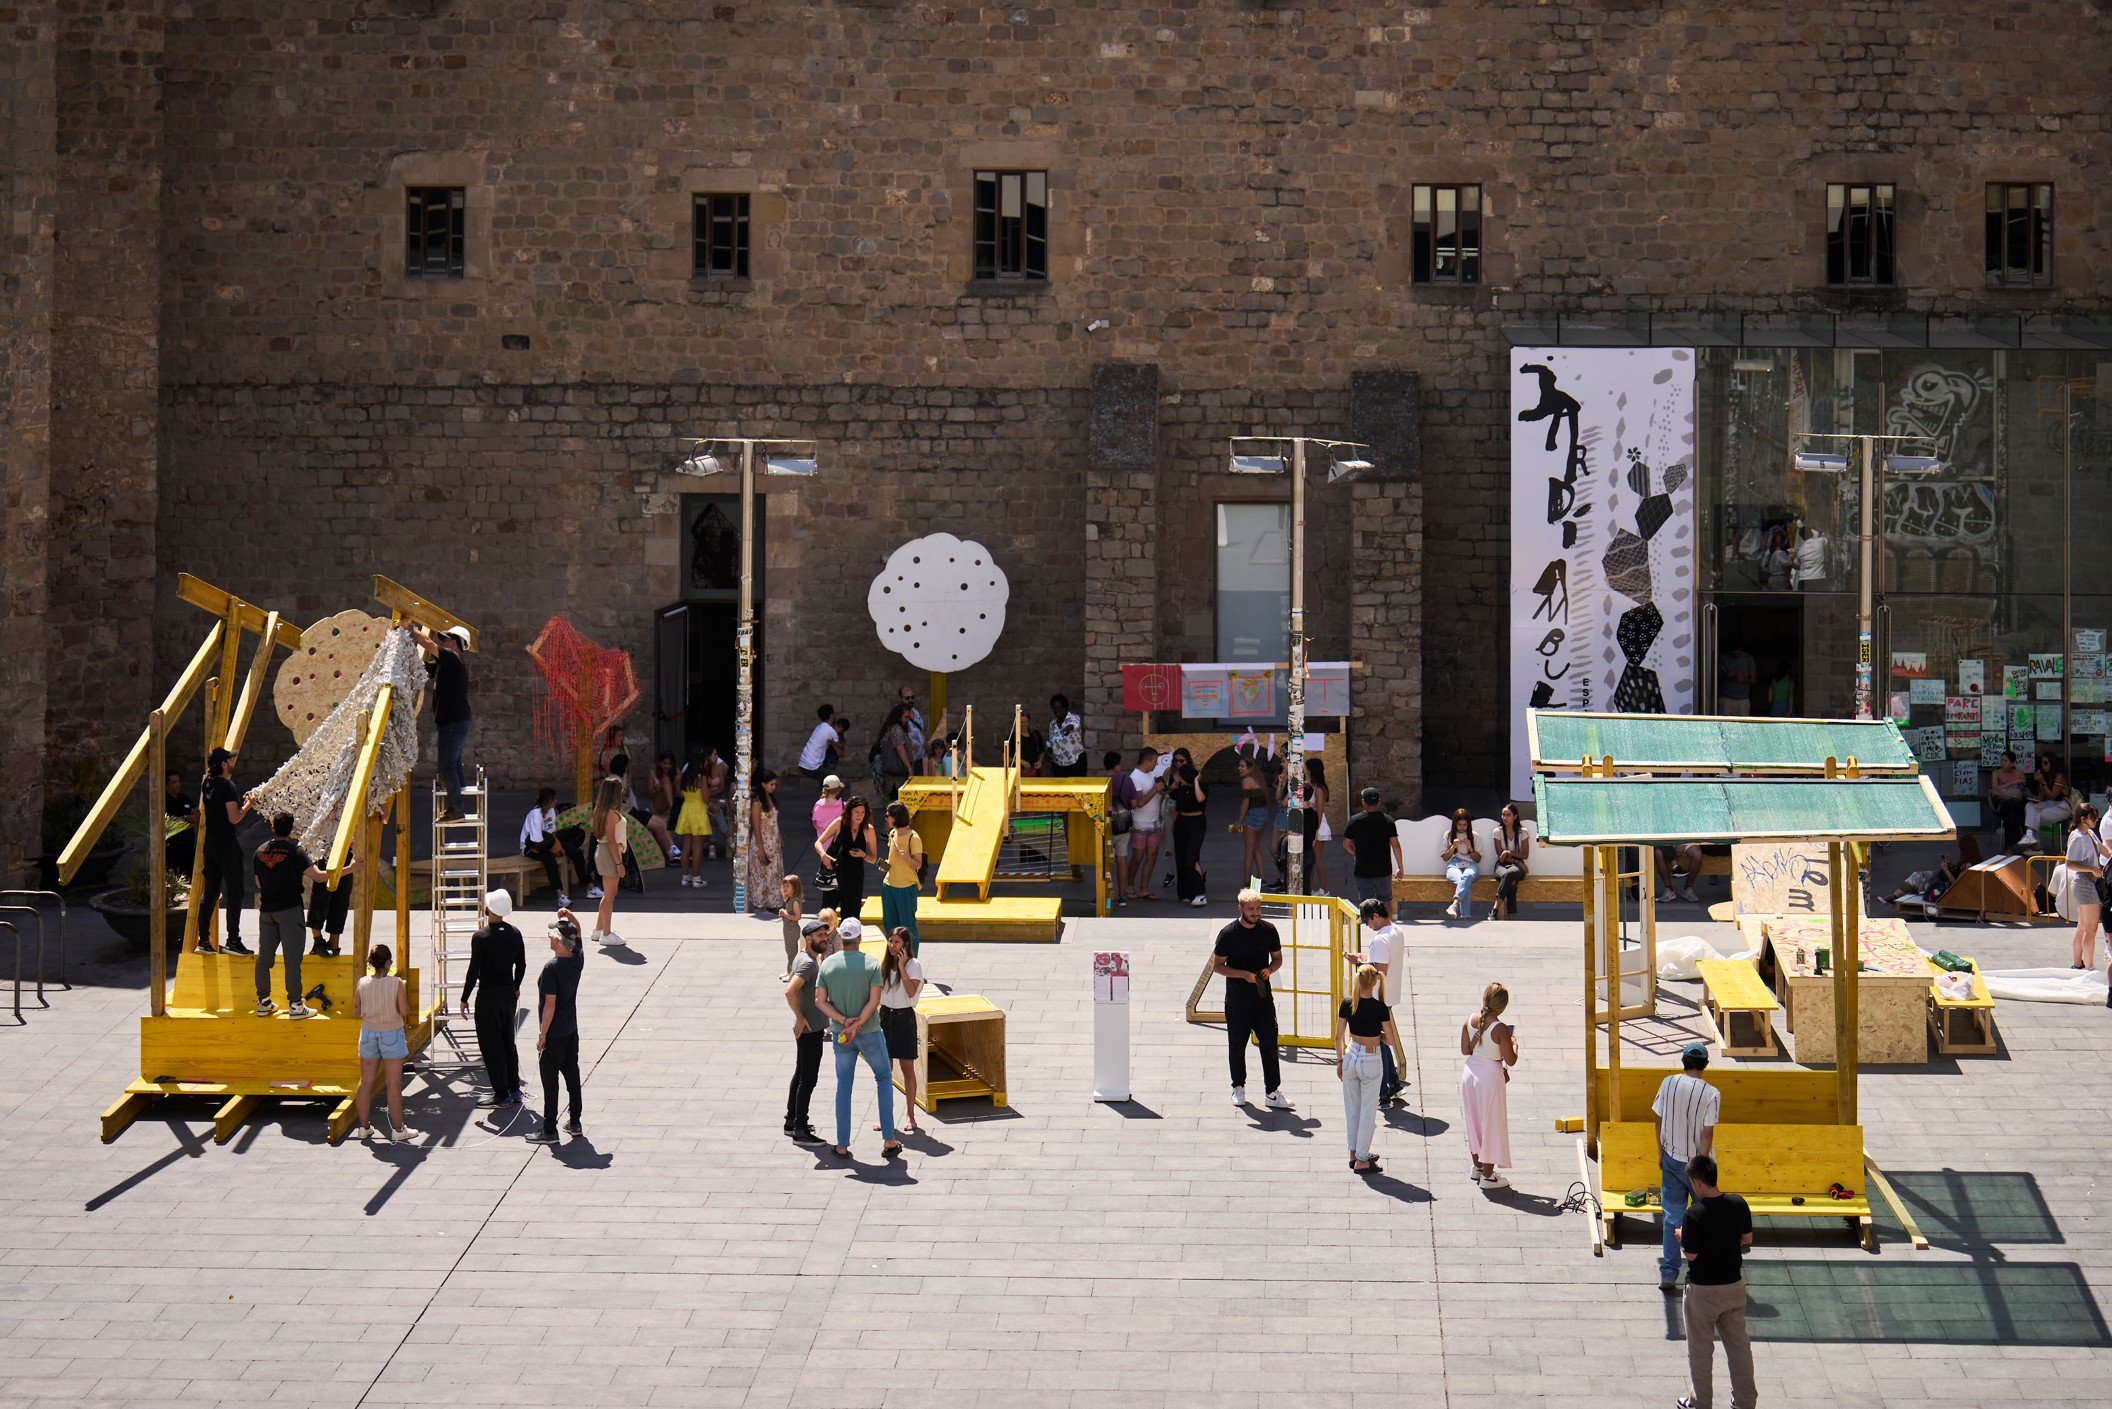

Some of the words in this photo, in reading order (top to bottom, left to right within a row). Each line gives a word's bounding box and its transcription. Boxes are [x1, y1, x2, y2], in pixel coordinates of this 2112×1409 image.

[2029, 656, 2058, 675] RAVAL
[1582, 678, 1590, 712] ESP
[1947, 698, 1979, 709] PARC
